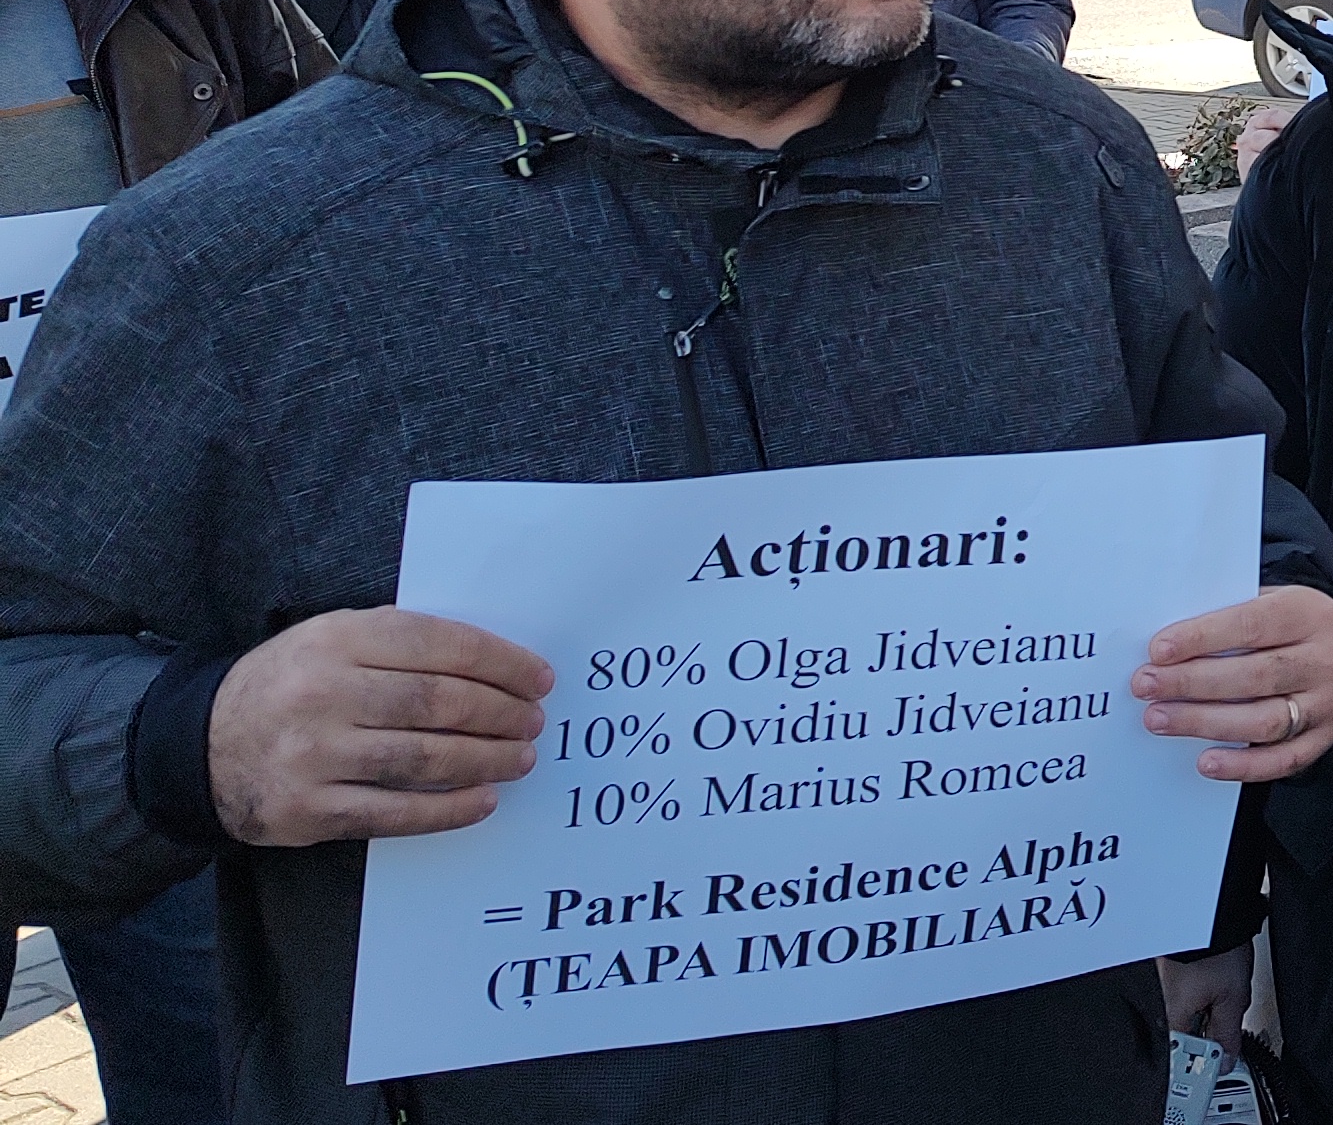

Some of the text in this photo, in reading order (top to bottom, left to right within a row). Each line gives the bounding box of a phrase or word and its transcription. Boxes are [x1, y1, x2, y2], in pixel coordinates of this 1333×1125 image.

[686, 515, 1030, 591] Acționari:
[586, 626, 1098, 692] 80% Olga Jidveianu
[554, 689, 1111, 762] 10% Ovidiu Jidveianu
[565, 751, 1088, 828] 10% Marius Romcea
[541, 879, 684, 933] Park
[703, 861, 970, 916] Residence
[980, 830, 1121, 885] Alpha
[486, 876, 1107, 1011] (ȚEAPA IMOBILIARĂ)
